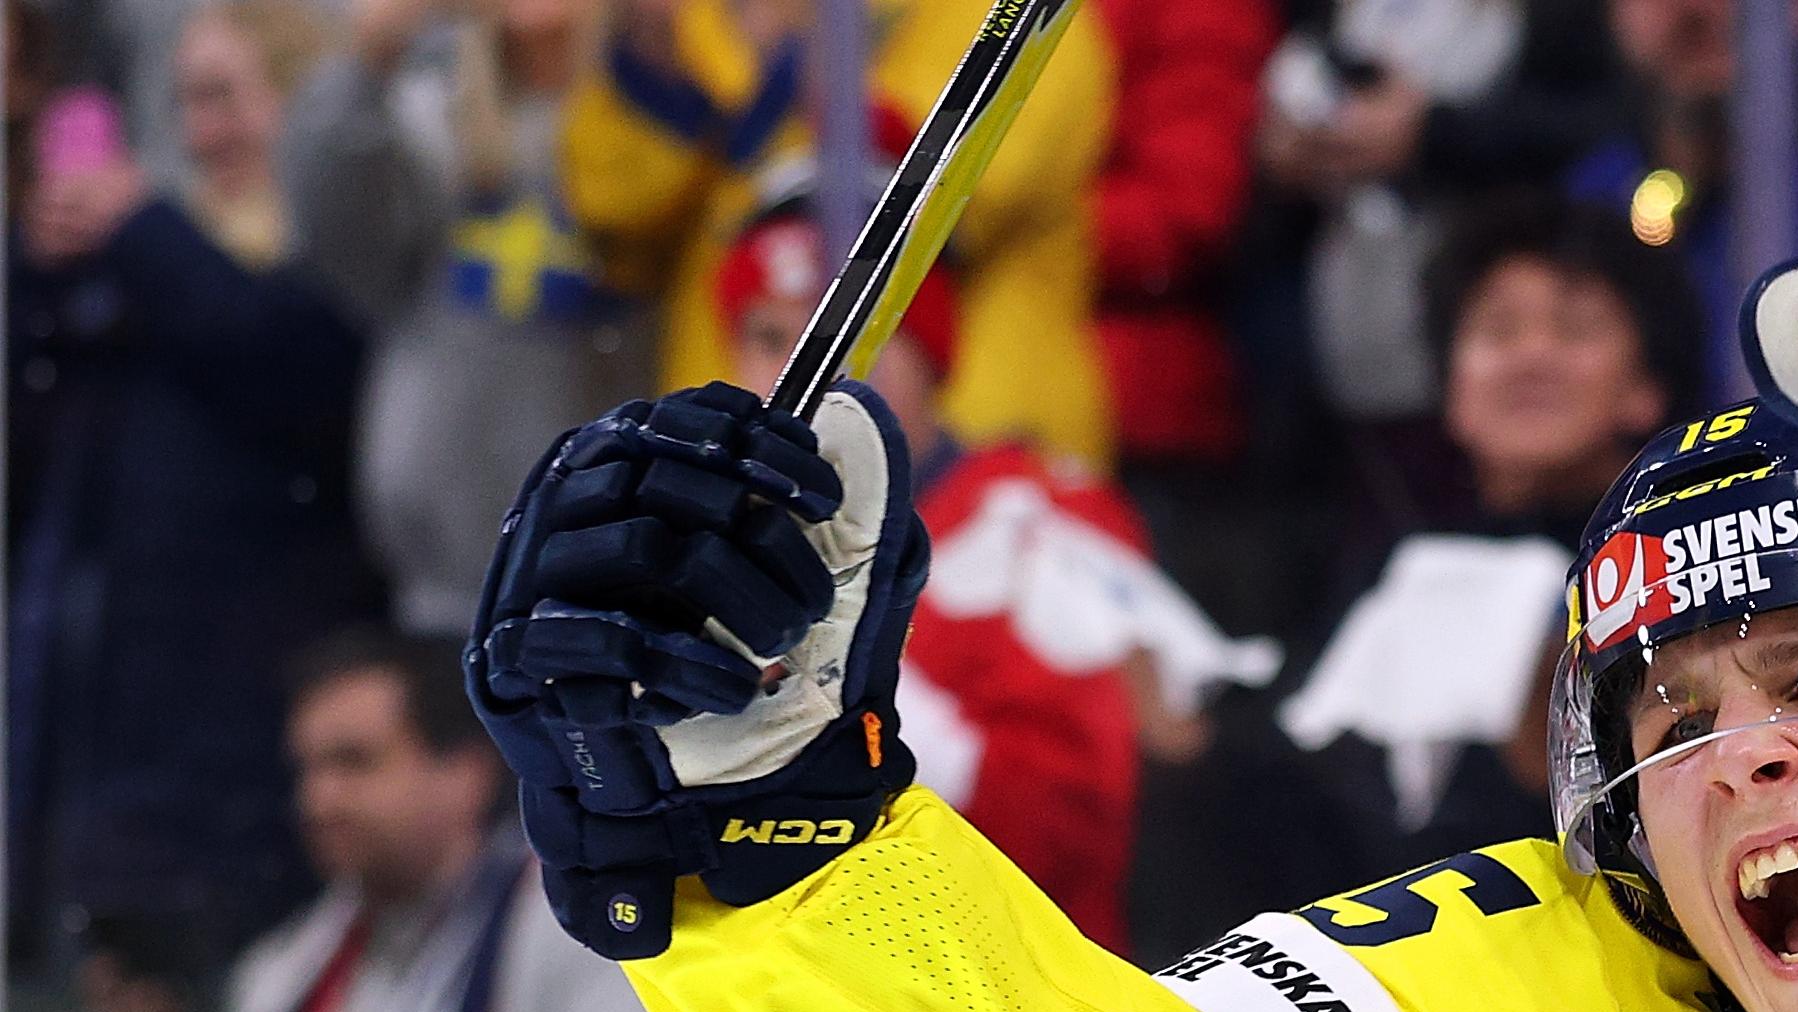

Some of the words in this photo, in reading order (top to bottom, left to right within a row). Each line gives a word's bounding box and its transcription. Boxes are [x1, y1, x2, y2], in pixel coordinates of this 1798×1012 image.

[992, 0, 1027, 38] LAN
[1679, 406, 1754, 453] 15
[1666, 553, 1771, 615] SPEL
[720, 818, 856, 845] CCM
[614, 902, 637, 925] 15
